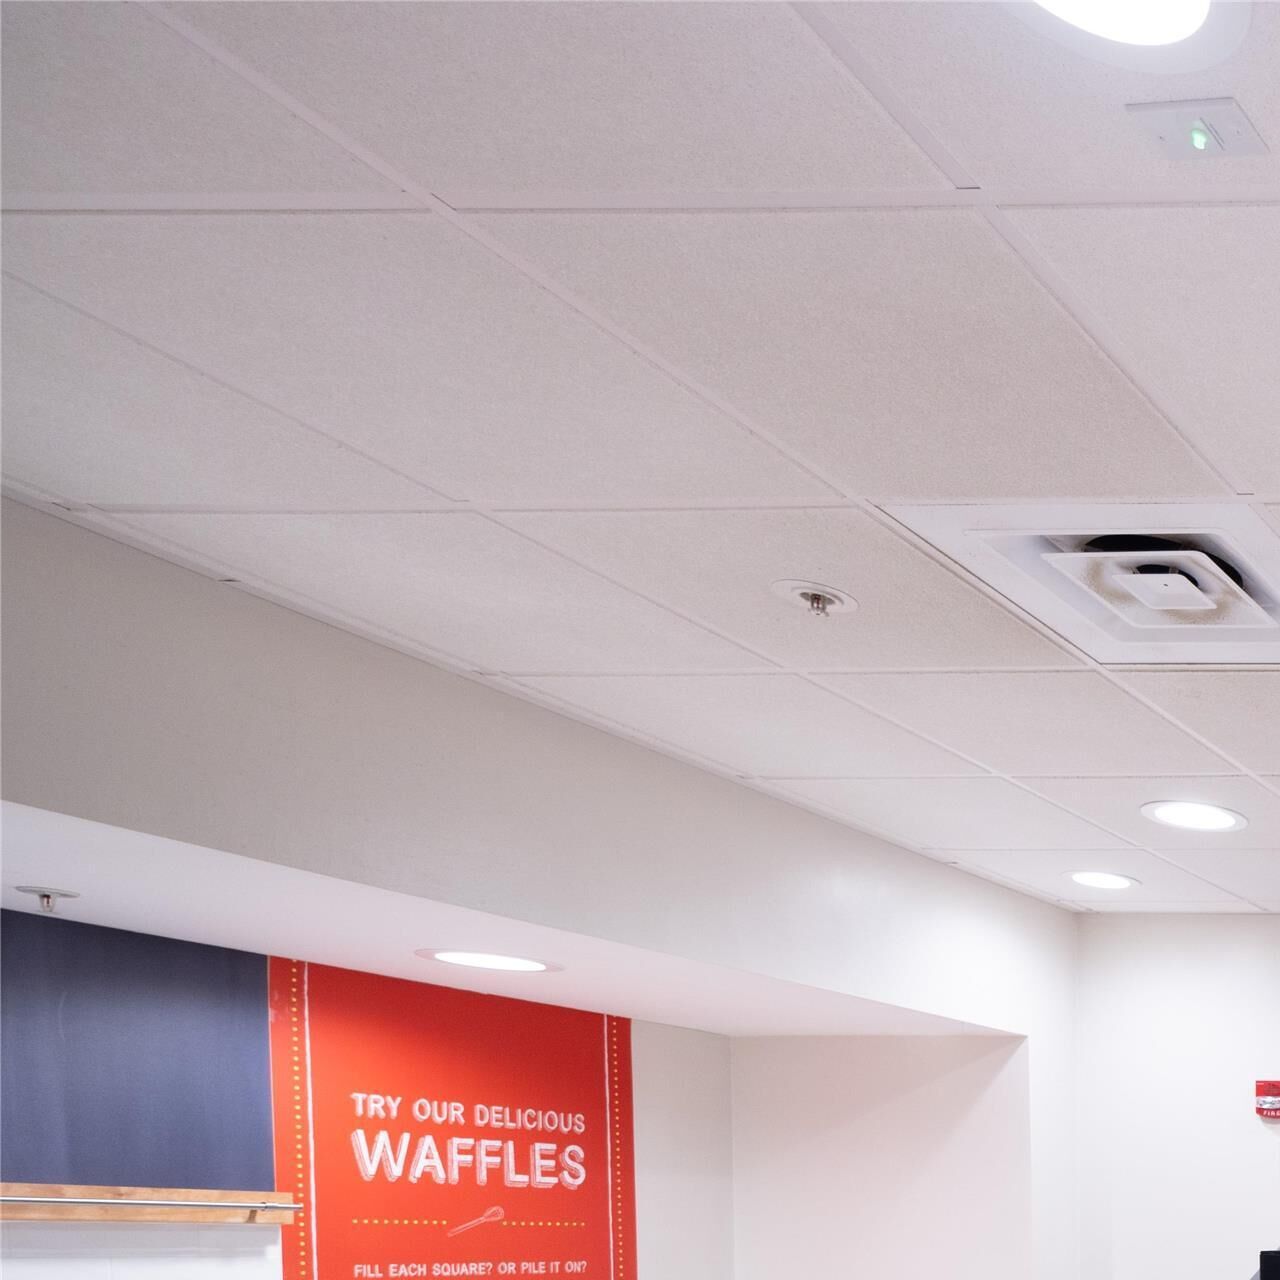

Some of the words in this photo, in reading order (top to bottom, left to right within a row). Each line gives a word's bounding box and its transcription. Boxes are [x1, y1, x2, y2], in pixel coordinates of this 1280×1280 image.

[351, 1092, 402, 1119] TRY
[412, 1098, 465, 1125] OUR
[474, 1104, 586, 1135] DELICIOUS
[351, 1128, 587, 1190] WAFFLES
[354, 1263, 383, 1278] FILL
[389, 1263, 427, 1277] EACH
[432, 1262, 493, 1276] SQUARE?
[498, 1261, 516, 1274] OR
[521, 1261, 546, 1274] PILE
[550, 1261, 560, 1273] IT
[565, 1260, 588, 1273] ON?
